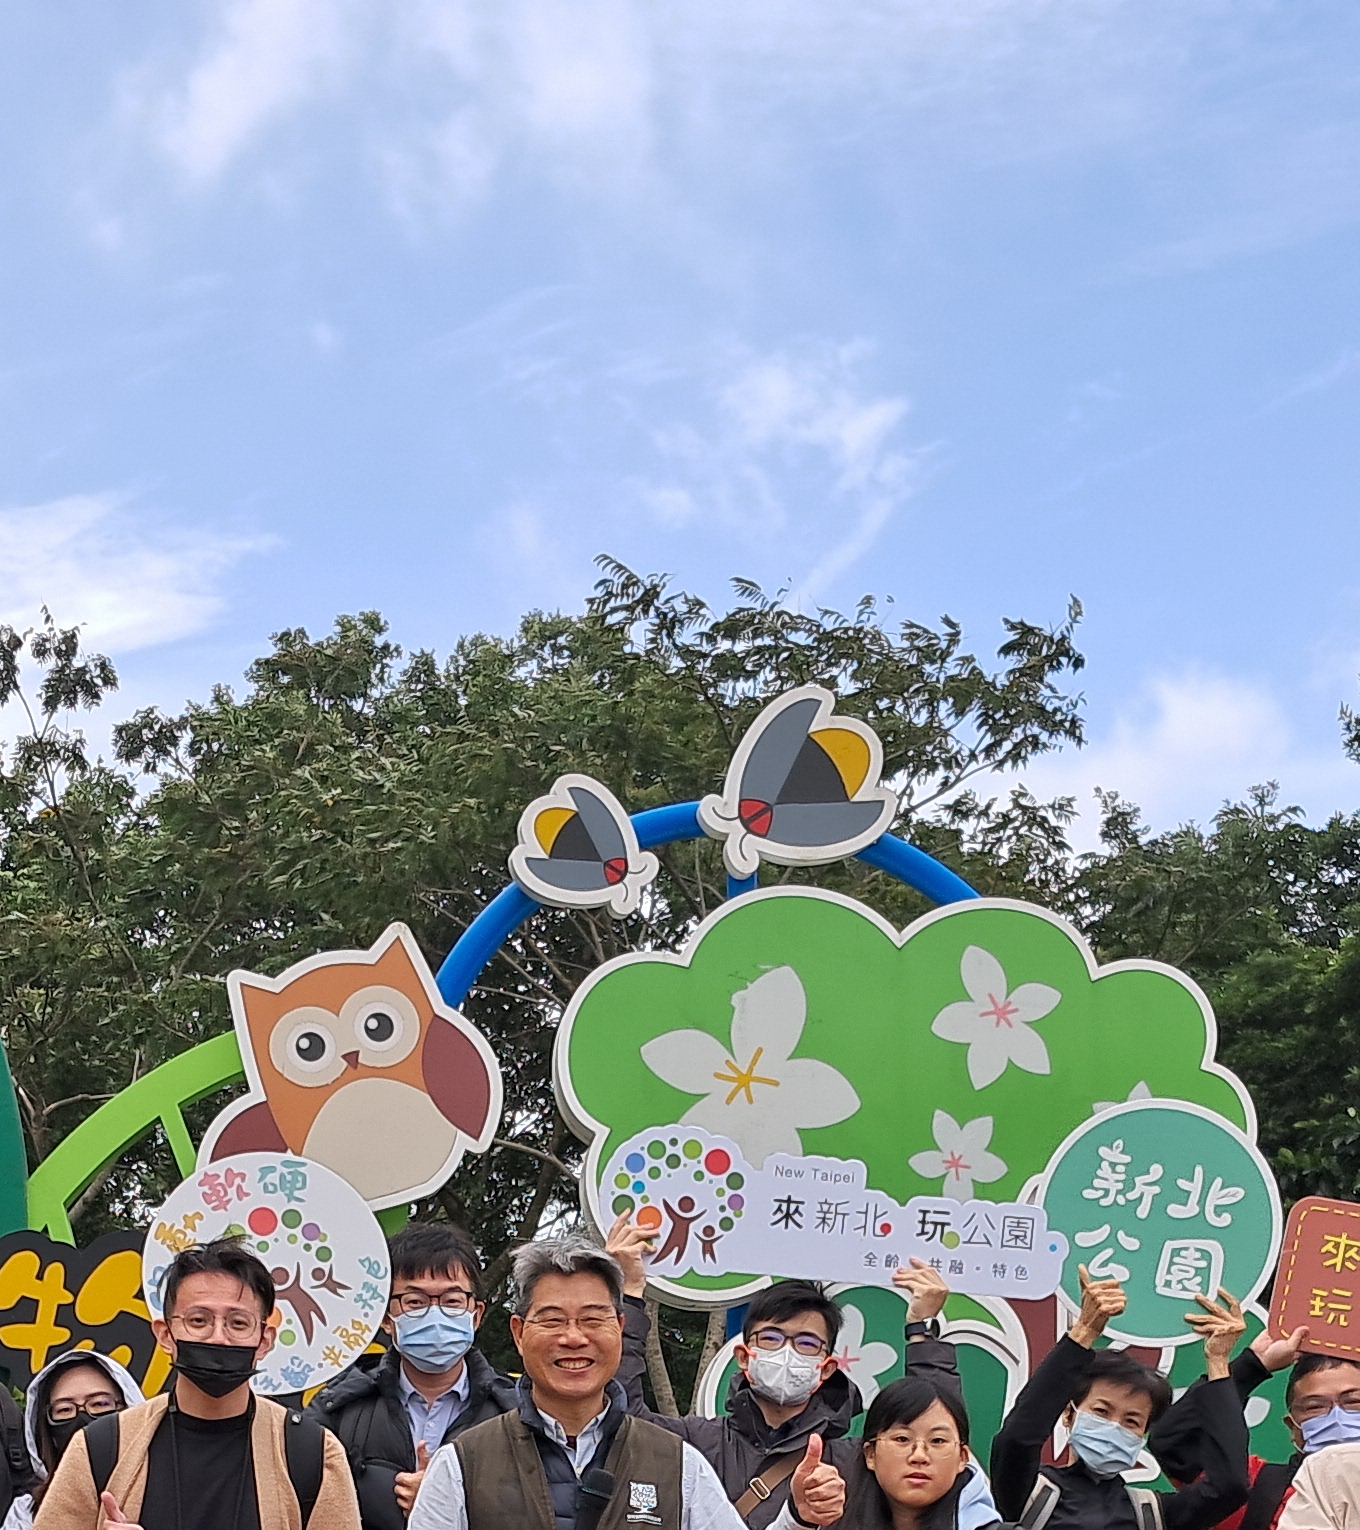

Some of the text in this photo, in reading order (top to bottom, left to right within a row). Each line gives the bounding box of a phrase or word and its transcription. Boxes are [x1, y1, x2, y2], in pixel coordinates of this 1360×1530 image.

[774, 1165, 856, 1185] New Taipei
[1081, 1139, 1245, 1228] 新北
[769, 1194, 1036, 1252] 來新北 玩公園
[1073, 1223, 1225, 1303] 公園
